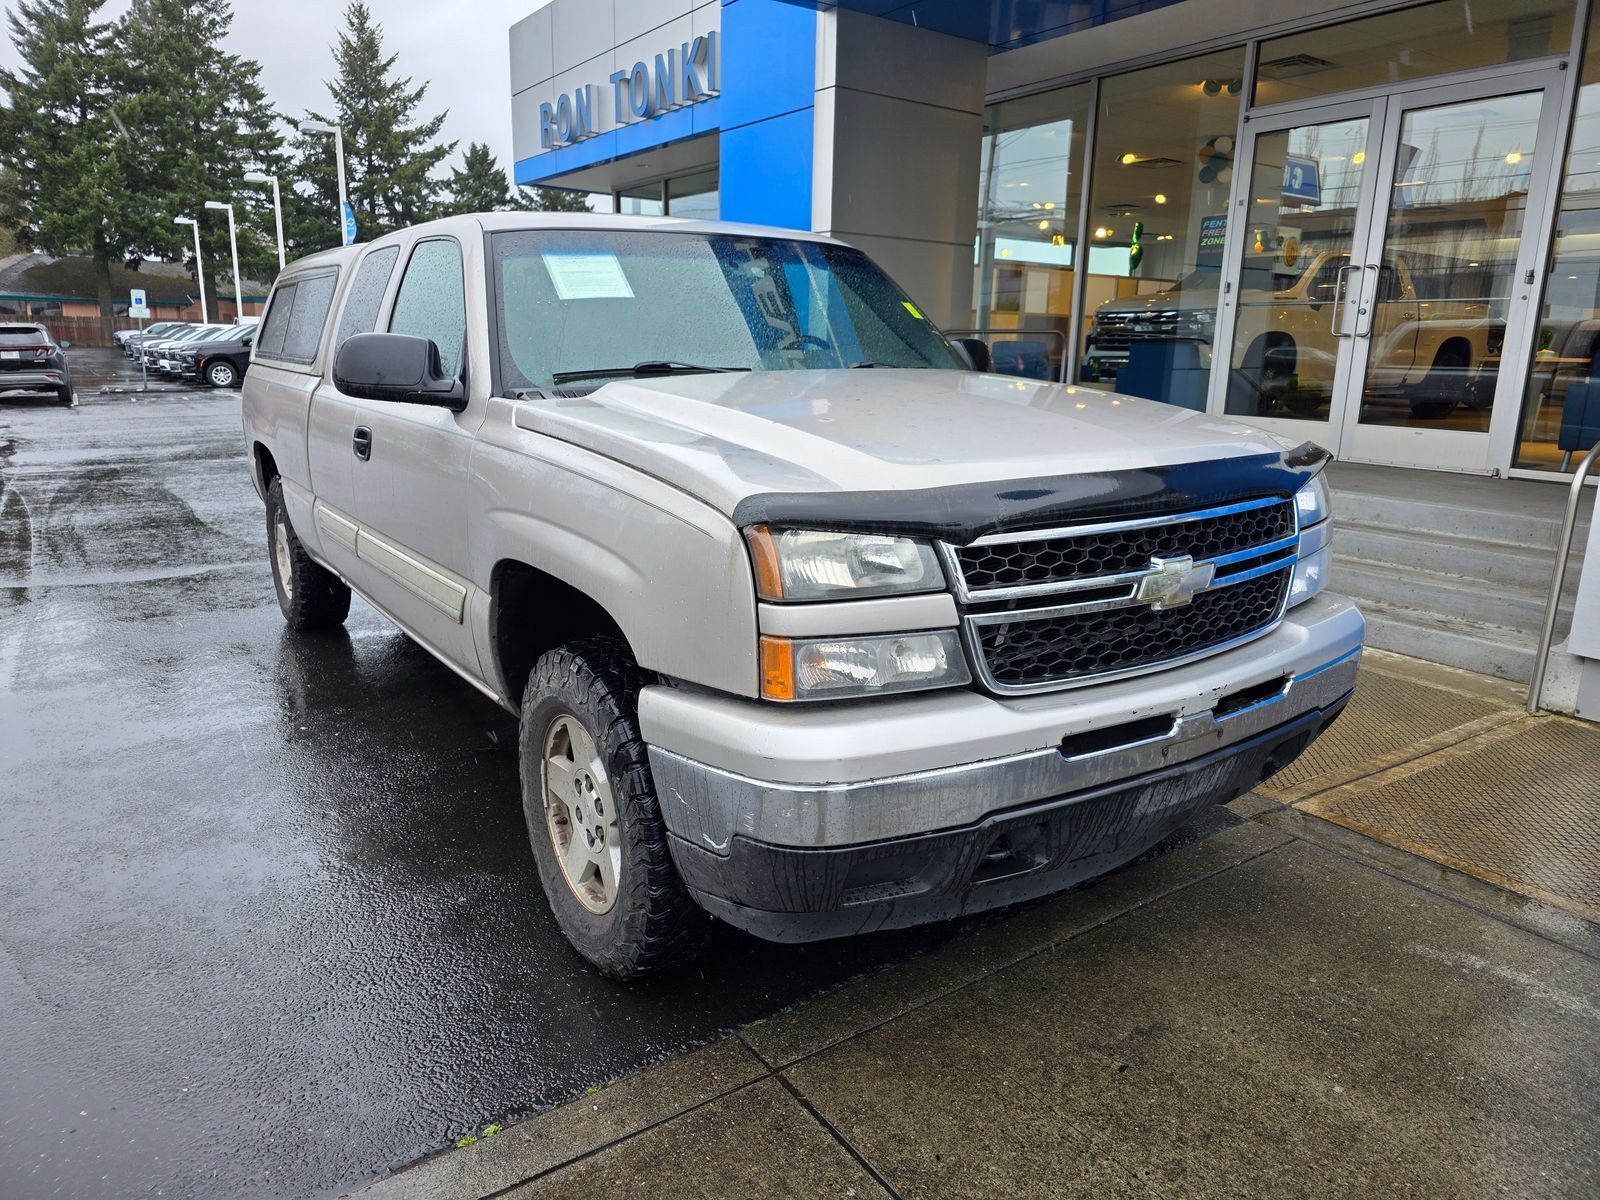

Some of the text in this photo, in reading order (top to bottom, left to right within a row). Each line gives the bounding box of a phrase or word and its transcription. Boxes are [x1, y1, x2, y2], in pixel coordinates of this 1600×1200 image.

[540, 31, 720, 149] RON TONKI
[1200, 237, 1225, 246] ZONE
